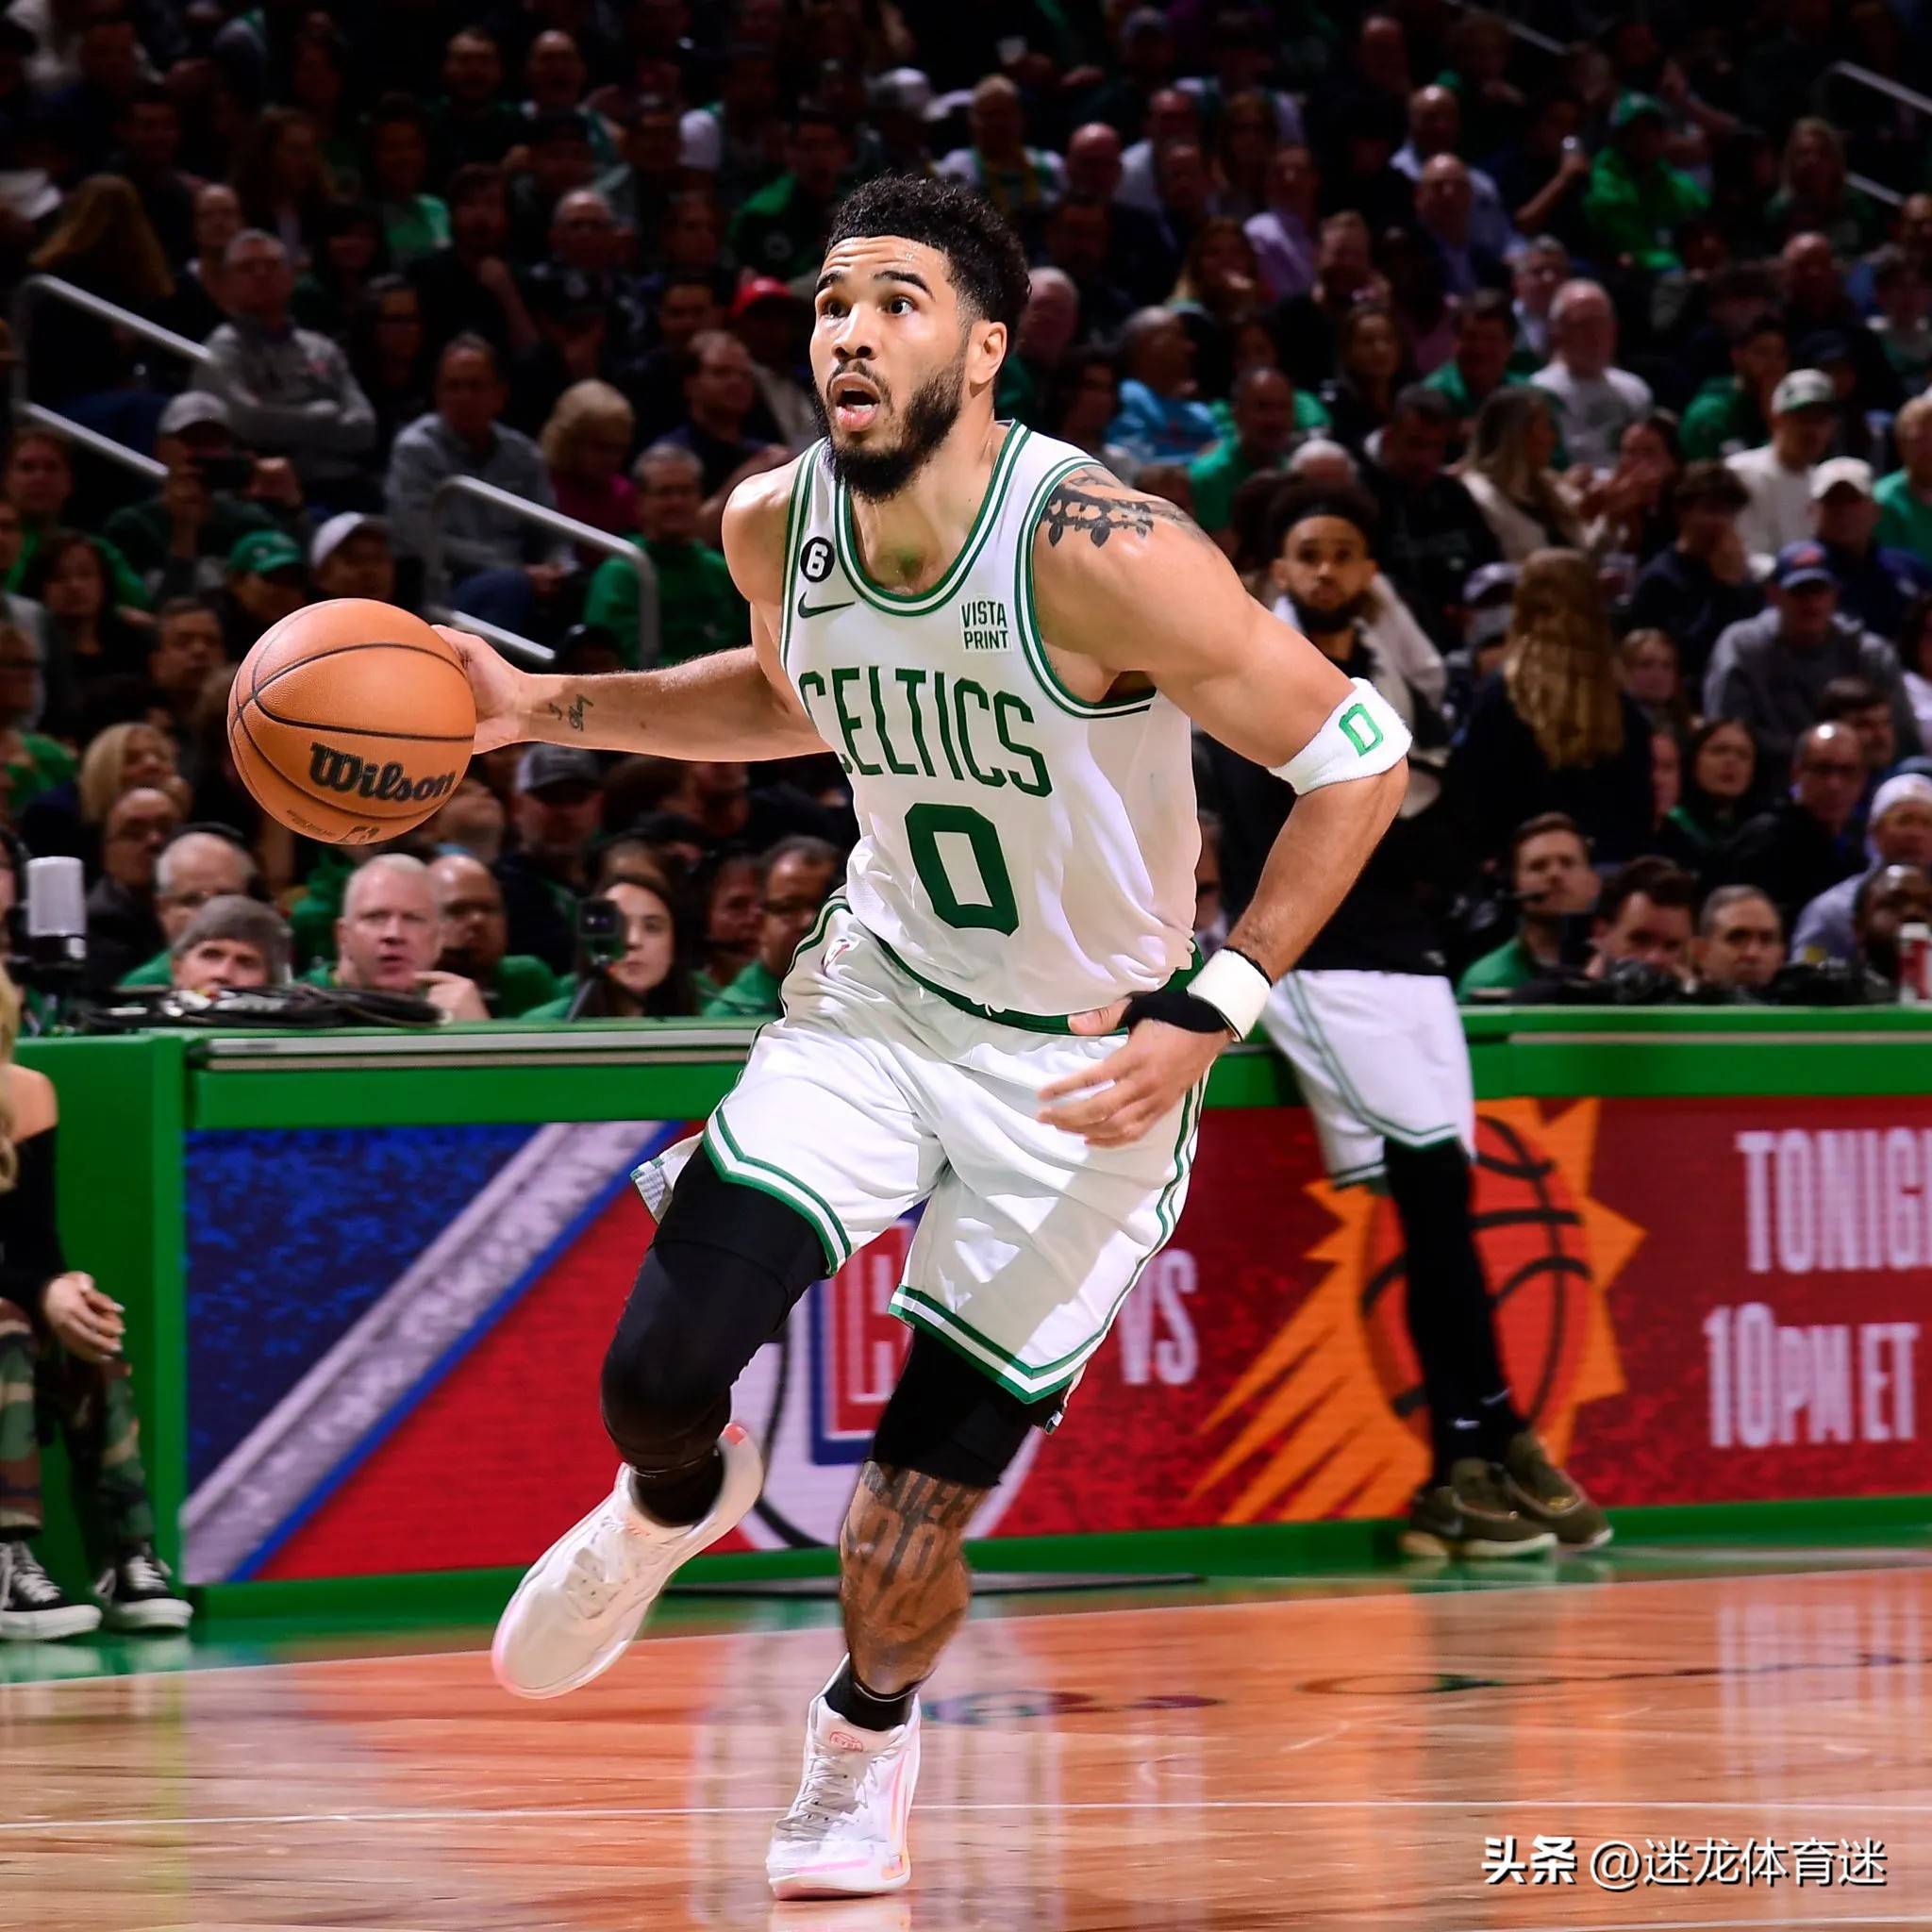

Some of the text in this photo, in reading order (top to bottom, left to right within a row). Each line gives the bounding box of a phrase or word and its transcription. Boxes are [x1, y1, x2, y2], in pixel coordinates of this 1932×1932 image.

[806, 540, 828, 577] 6
[960, 600, 1008, 628] VISTA
[963, 629, 1009, 650] PRINT
[309, 741, 457, 802] Wilson
[904, 802, 1020, 937] 0
[1857, 1322, 1921, 1441] ET
